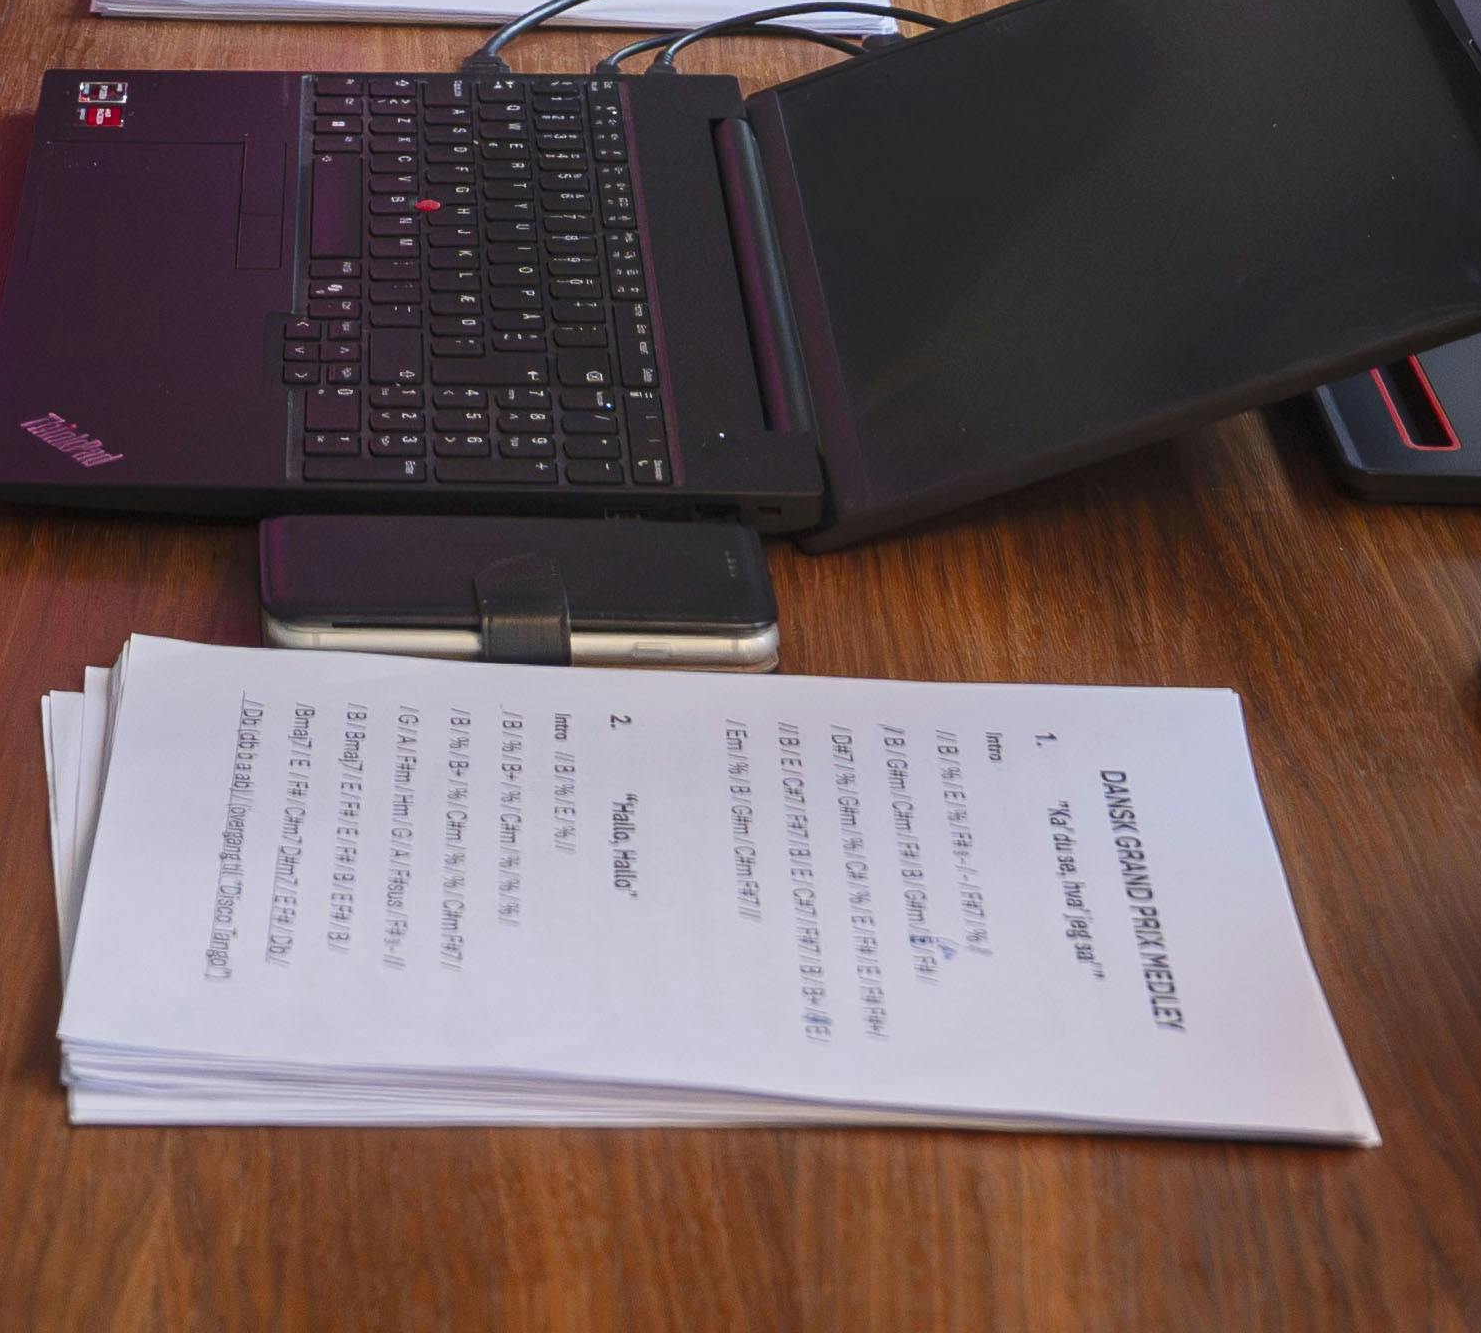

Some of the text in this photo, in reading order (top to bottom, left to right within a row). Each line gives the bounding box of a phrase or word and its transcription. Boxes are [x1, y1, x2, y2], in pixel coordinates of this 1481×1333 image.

[20, 412, 124, 468] ThinkPad
[555, 713, 571, 740] Intro
[610, 715, 631, 728] 2.
[986, 732, 1002, 762] Intro
[1035, 732, 1057, 747] 1.
[1053, 834, 1076, 851] du
[1057, 854, 1080, 876] se,
[1100, 771, 1185, 1031] DANSK GRAND PRIX MEDLEY
[1064, 914, 1093, 939] jeg
